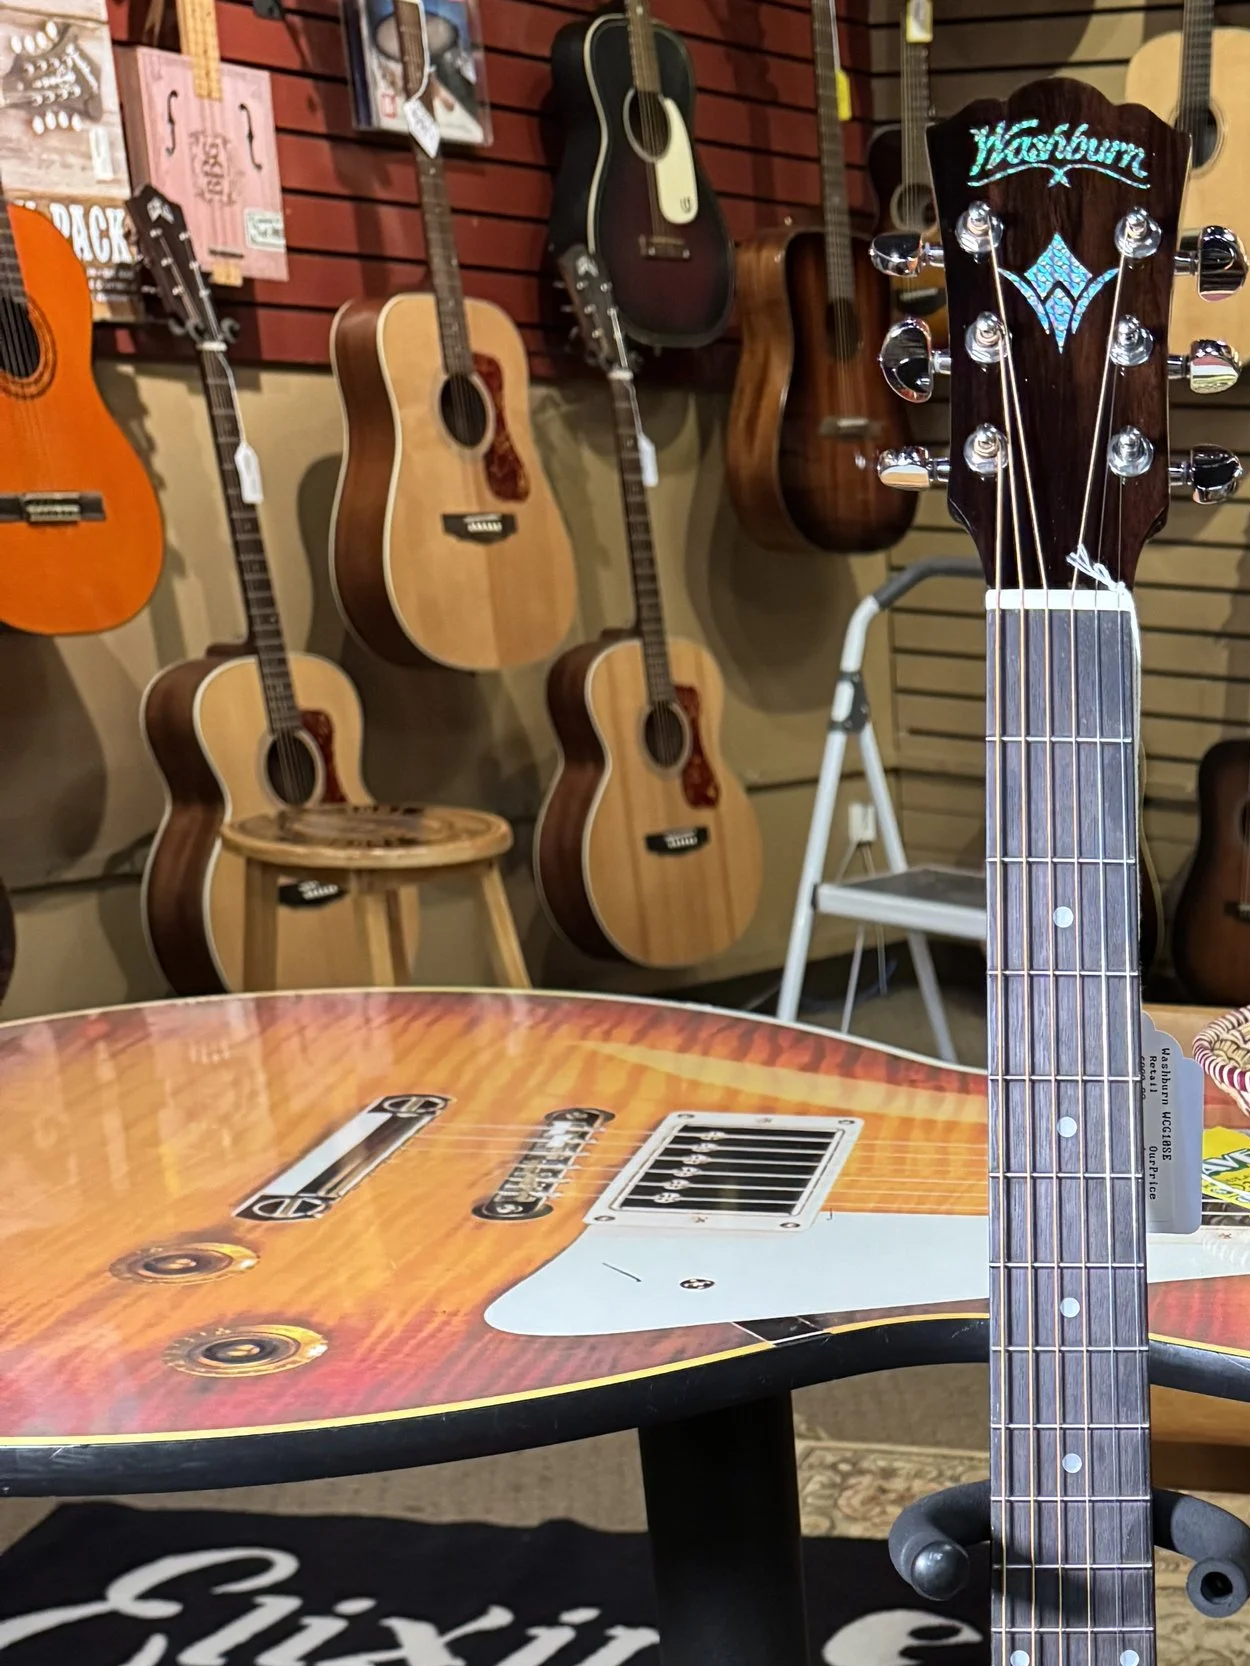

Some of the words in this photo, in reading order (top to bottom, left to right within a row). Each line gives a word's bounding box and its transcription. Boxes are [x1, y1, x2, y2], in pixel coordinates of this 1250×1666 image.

[969, 119, 1149, 178] Washburn
[49, 203, 132, 264] PACK
[1149, 1055, 1158, 1093] Retail
[1161, 1047, 1172, 1105] Washburn
[1149, 1145, 1159, 1200] OurPrice
